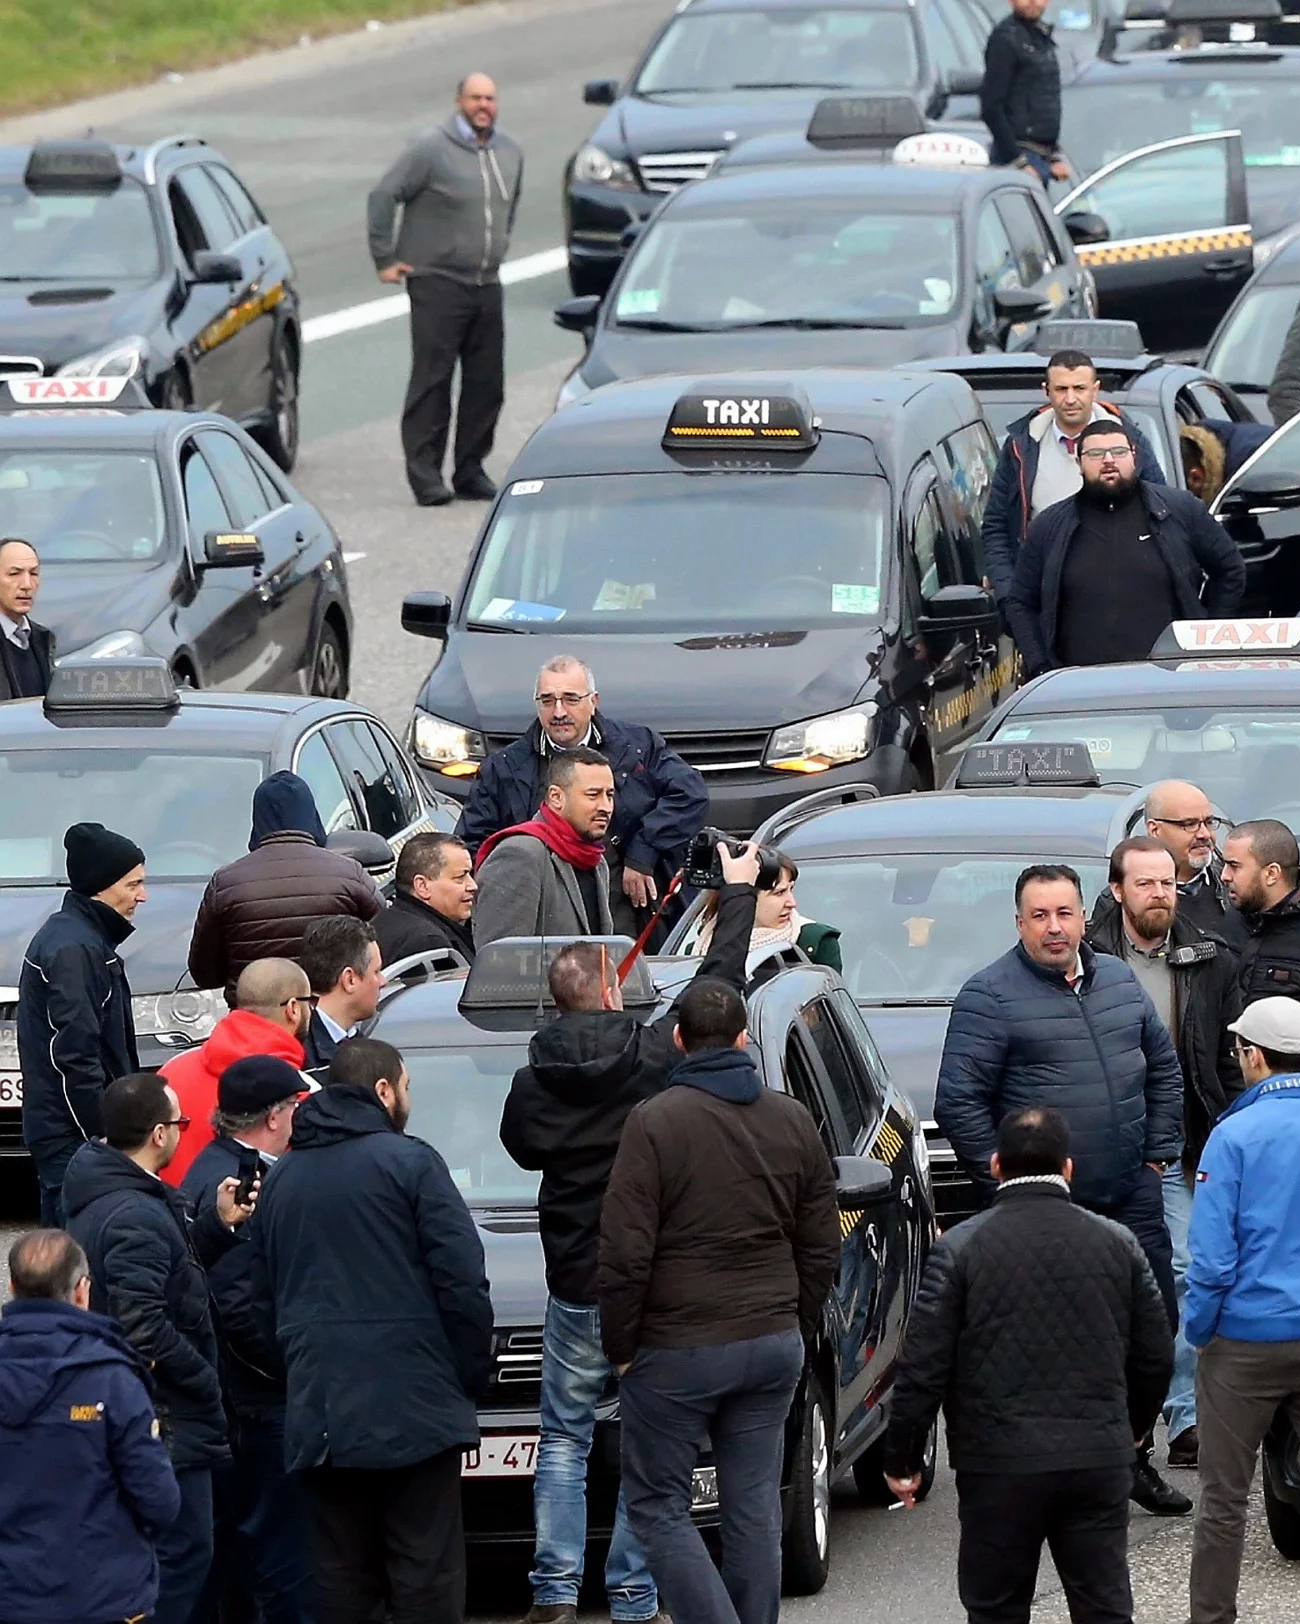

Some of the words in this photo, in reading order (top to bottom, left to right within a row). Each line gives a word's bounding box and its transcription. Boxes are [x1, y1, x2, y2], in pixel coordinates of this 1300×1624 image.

[915, 141, 963, 154] TAXI
[24, 381, 108, 398] TAXI
[703, 399, 769, 425] TAXI
[1189, 622, 1289, 645] TAXI
